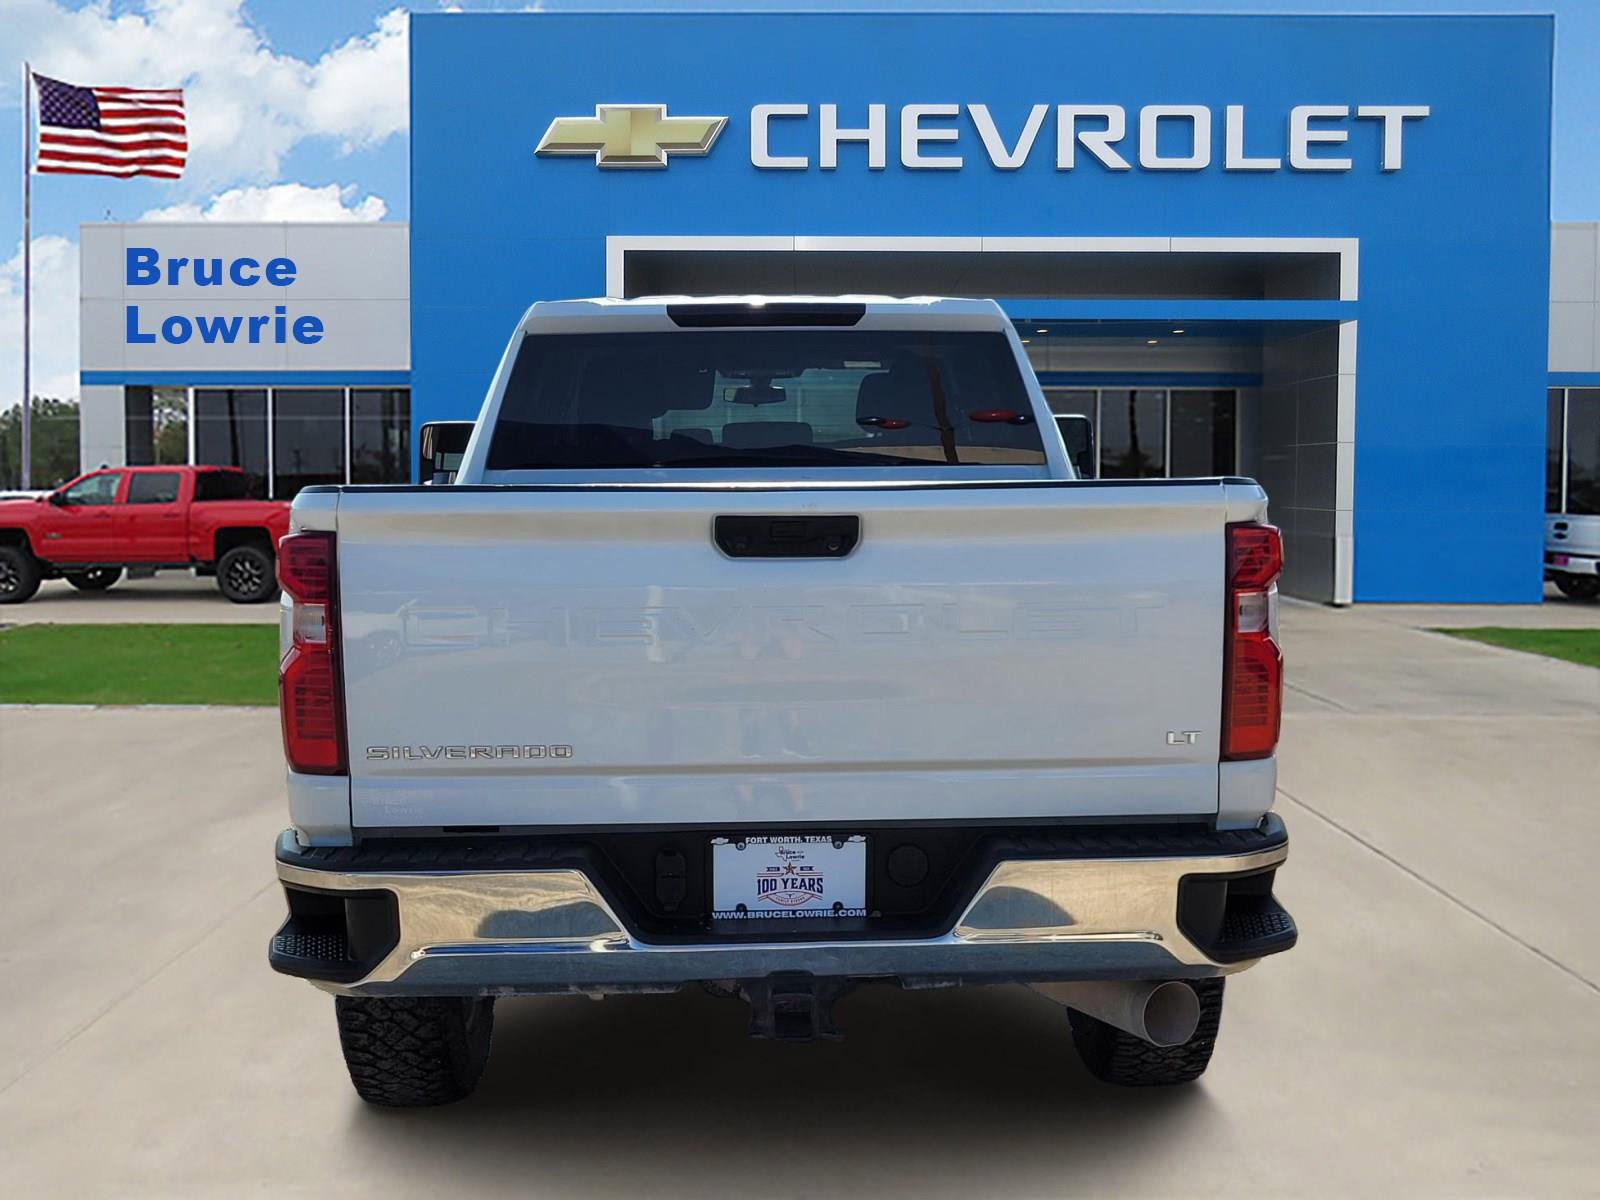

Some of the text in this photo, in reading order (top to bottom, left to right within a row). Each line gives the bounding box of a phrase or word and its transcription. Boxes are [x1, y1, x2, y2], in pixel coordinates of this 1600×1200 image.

[750, 103, 1431, 171] CHEVROLET
[126, 247, 297, 287] Bruce
[126, 305, 325, 345] Lowrie
[1166, 730, 1202, 745] LT
[366, 744, 574, 761] SILVERADO
[745, 836, 768, 844] FORT
[804, 835, 832, 843] TEXAS
[757, 877, 824, 896] 100 YEARS
[712, 909, 867, 920] WWW.BRUCELOWRIE.COM
